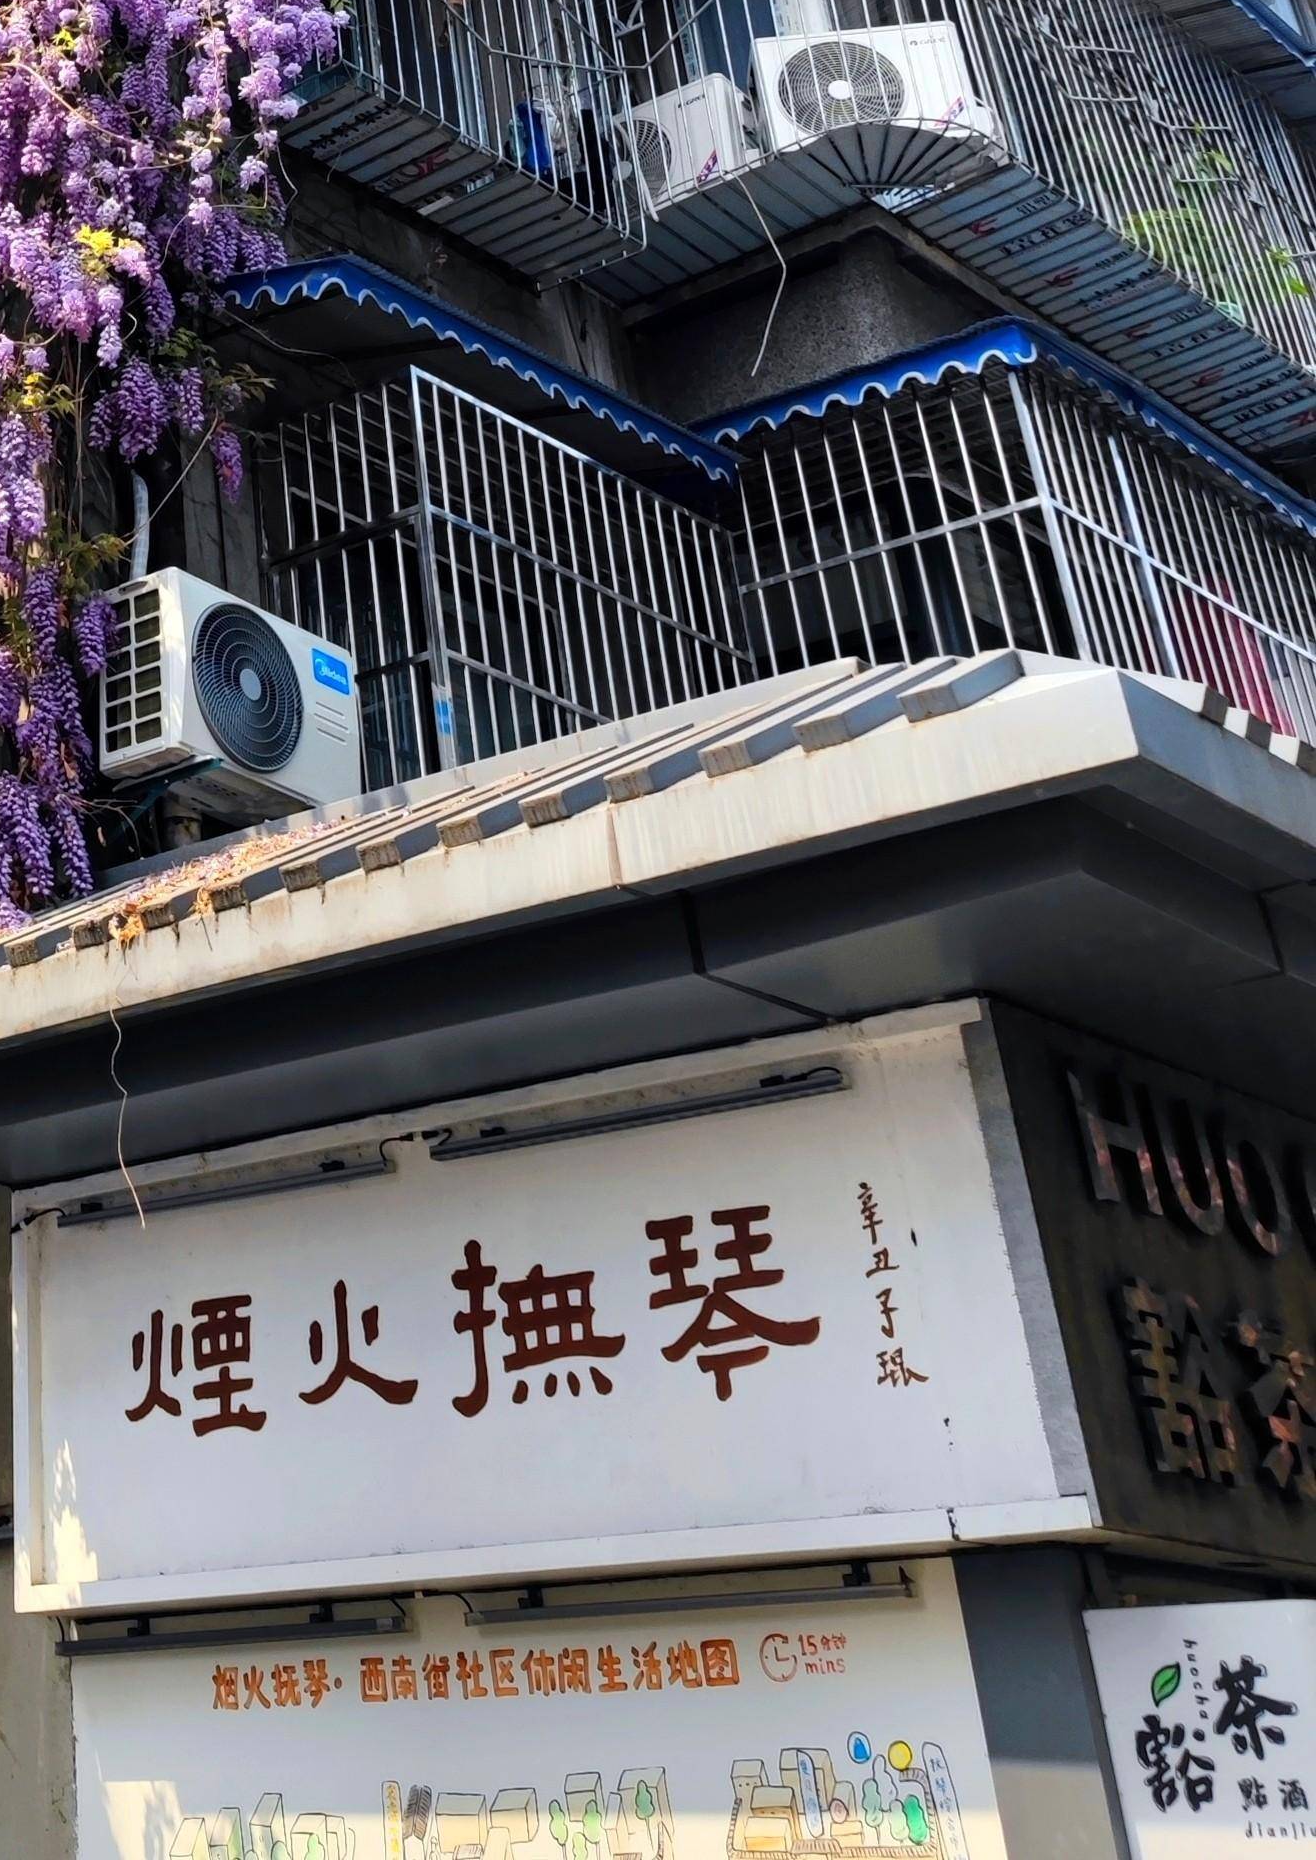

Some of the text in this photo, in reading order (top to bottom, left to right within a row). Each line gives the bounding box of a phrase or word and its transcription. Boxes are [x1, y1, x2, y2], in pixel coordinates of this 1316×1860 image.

[1068, 1068, 1316, 1260] HUO
[125, 1204, 821, 1437] 煙火撫琴
[805, 1658, 846, 1675] mins
